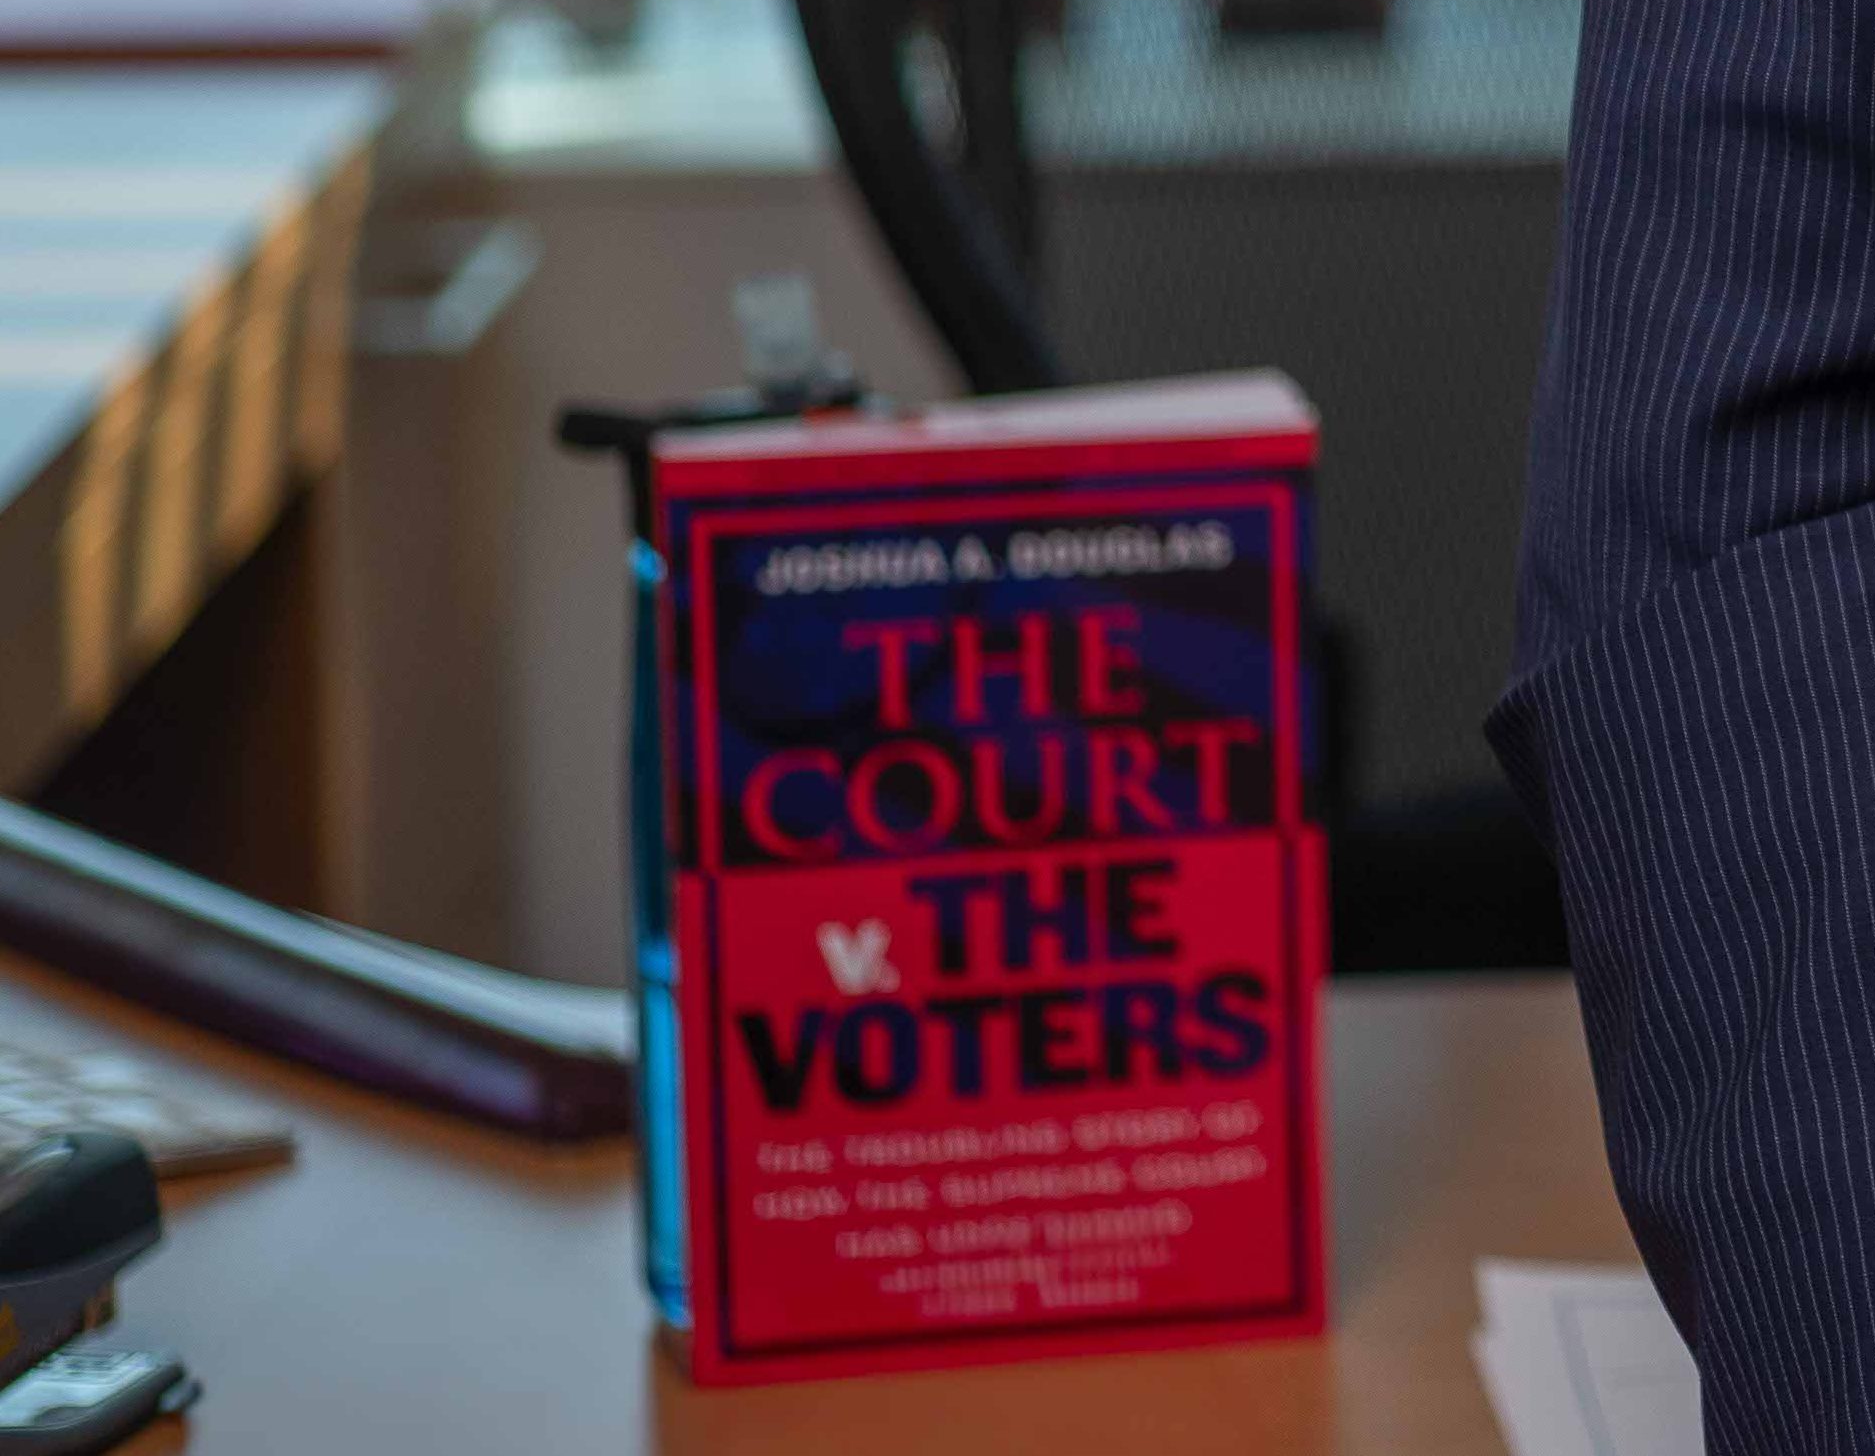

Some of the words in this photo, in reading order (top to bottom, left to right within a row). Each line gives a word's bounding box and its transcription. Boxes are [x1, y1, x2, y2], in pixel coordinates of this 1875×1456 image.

[758, 538, 948, 595] JOSHUA
[1007, 519, 1234, 580] DOUGLAS
[843, 606, 1144, 729] THE
[740, 717, 1260, 861] COURT
[905, 858, 1180, 975] THE
[737, 971, 1269, 1113] VOTERS
